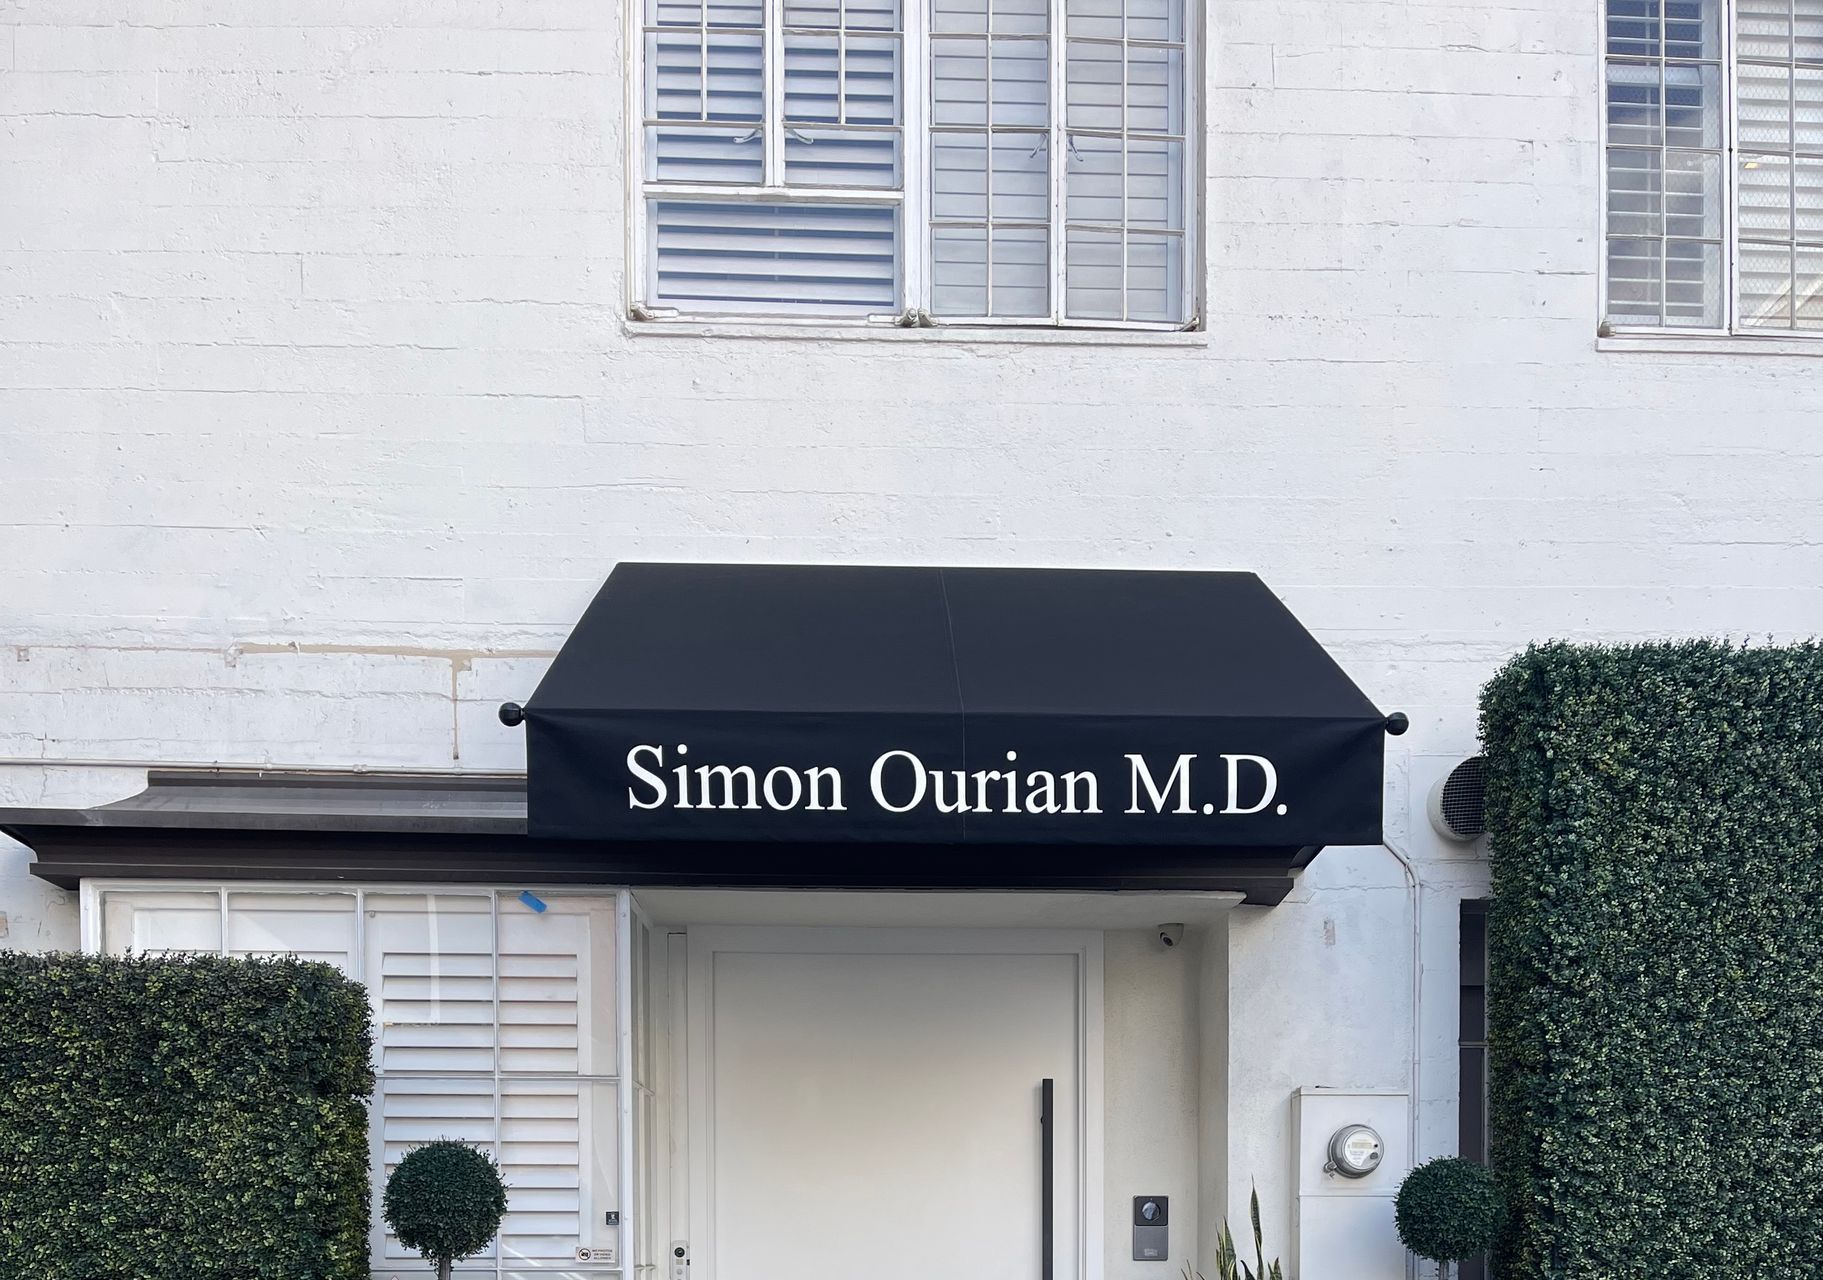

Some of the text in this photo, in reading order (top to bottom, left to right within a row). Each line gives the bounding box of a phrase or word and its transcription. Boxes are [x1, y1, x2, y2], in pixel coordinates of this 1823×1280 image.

[626, 744, 1288, 816] Simon Ourian M.D.
